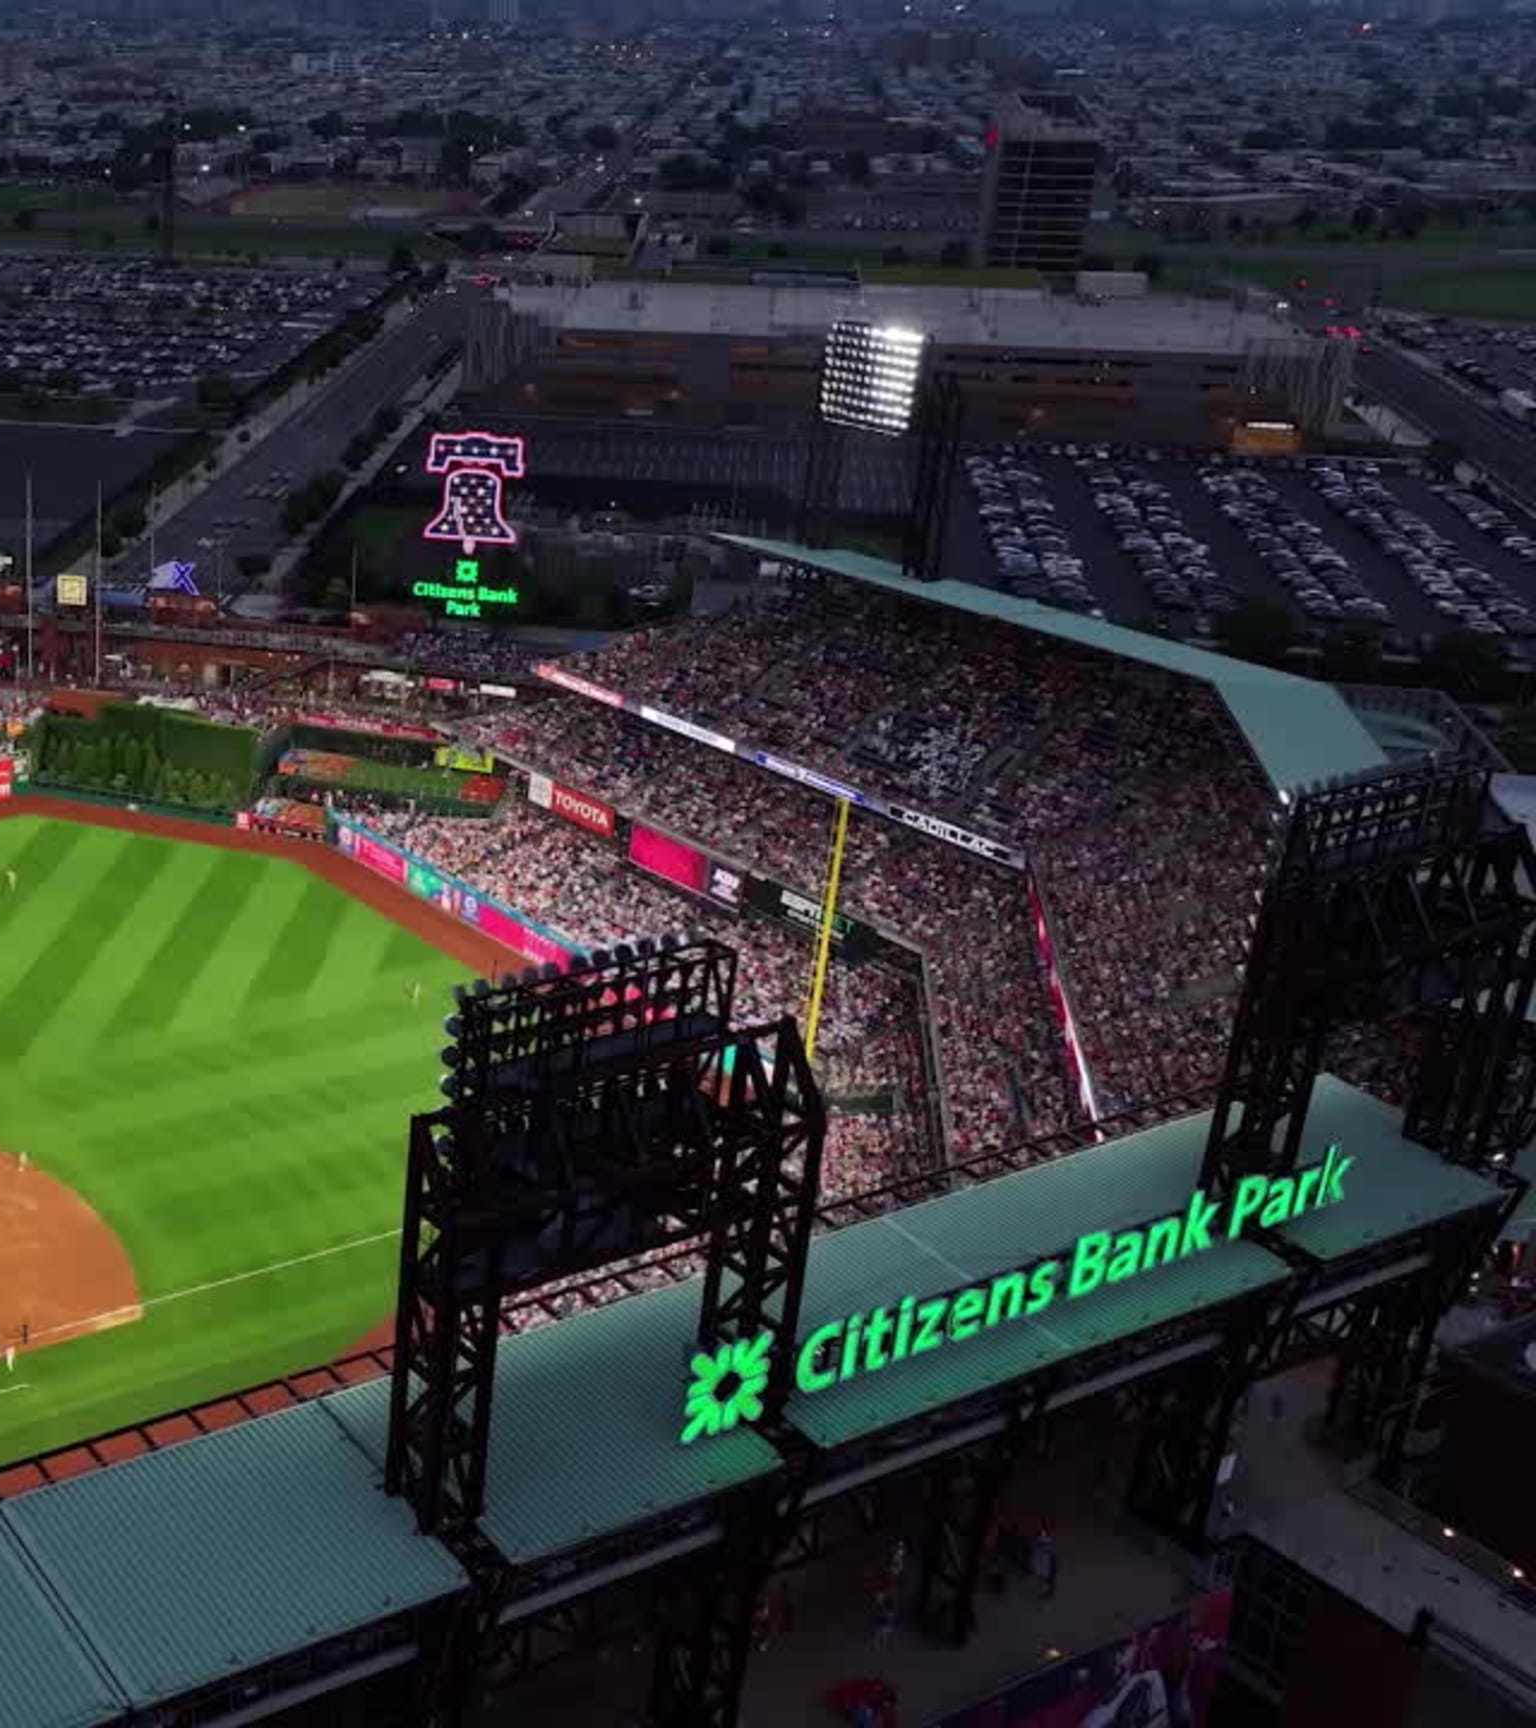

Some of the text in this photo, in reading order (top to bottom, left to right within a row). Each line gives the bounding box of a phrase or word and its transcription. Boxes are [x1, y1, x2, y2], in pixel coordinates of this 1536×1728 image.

[412, 581, 518, 603] Citizens Bank
[446, 600, 481, 617] Park
[552, 790, 610, 828] TOYOTA
[901, 811, 996, 858] CADILLAC
[794, 1142, 1356, 1394] Citizens Bank Park
